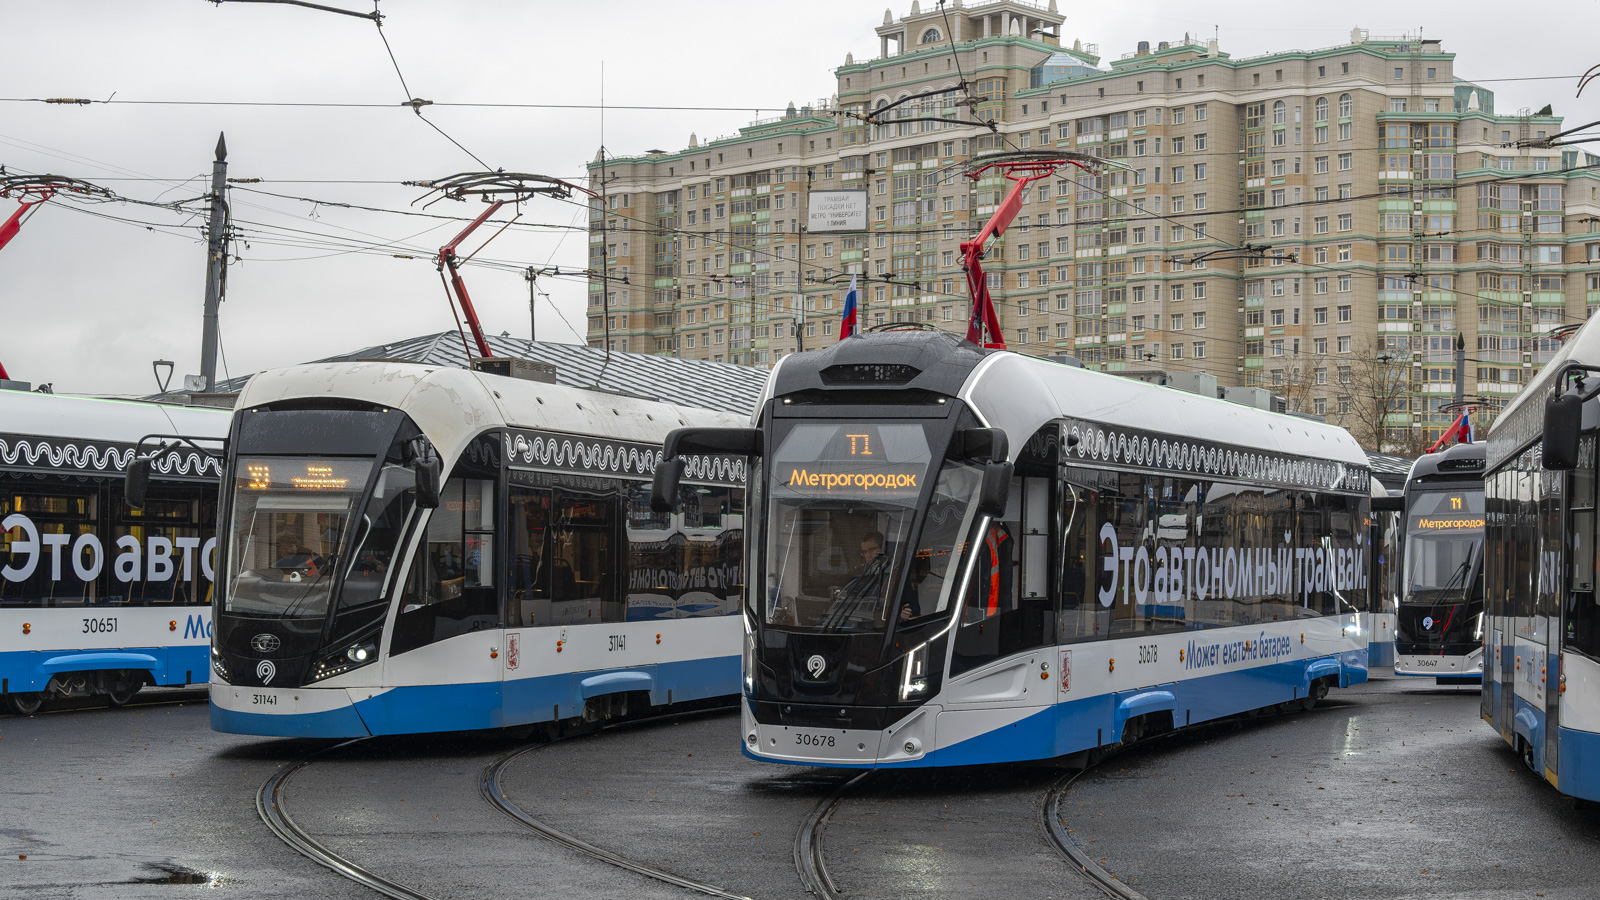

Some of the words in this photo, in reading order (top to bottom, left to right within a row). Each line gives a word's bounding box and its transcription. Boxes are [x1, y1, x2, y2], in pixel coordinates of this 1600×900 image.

[817, 203, 845, 211] ПОСАДКИ
[789, 468, 917, 490] Метрогородок
[0, 513, 104, 583] Это
[1098, 521, 1150, 607] Это
[1154, 529, 1293, 604] автономный
[82, 617, 118, 634] 30651
[608, 634, 626, 652] 31141
[1185, 639, 1220, 671] Может
[1222, 641, 1247, 666] ехать
[1248, 642, 1258, 660] на
[1259, 631, 1292, 663] батарее.
[1138, 644, 1158, 665] 30678
[1417, 659, 1438, 668] 30647
[252, 693, 277, 706] 31141
[795, 732, 836, 747] 30678
